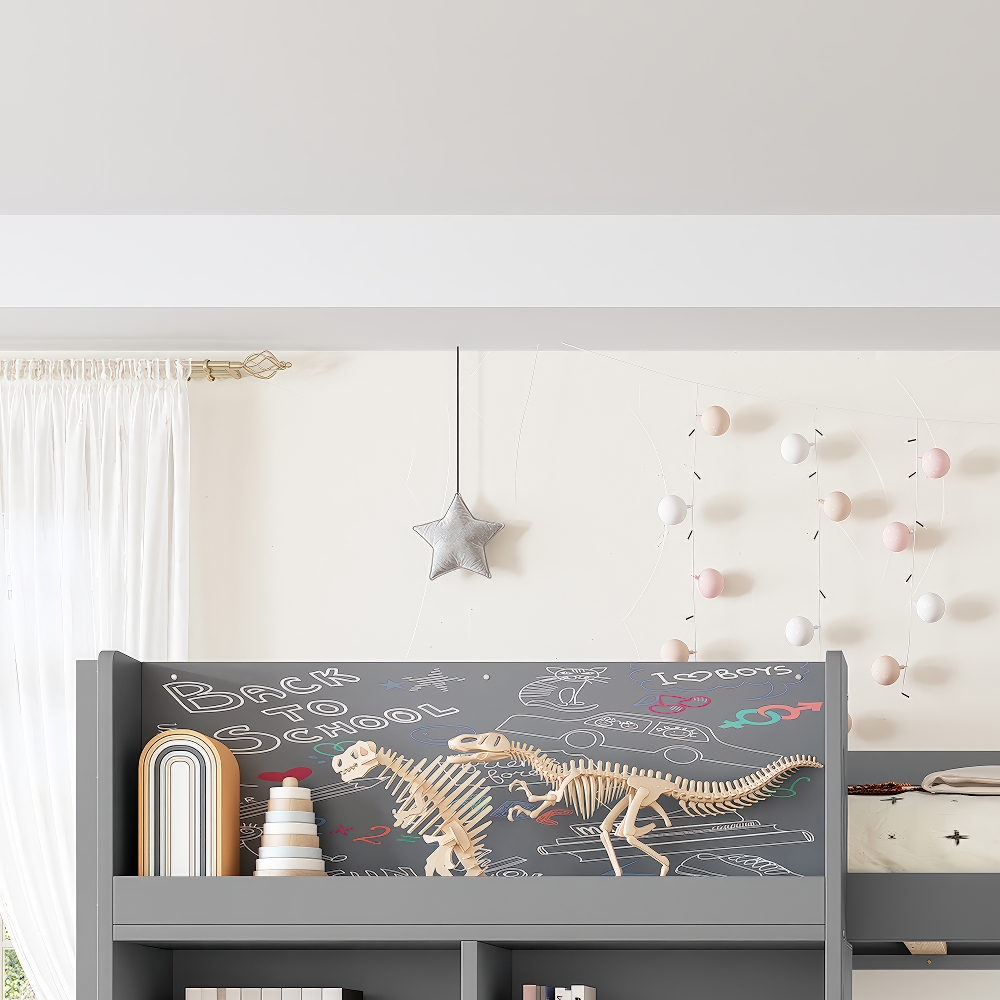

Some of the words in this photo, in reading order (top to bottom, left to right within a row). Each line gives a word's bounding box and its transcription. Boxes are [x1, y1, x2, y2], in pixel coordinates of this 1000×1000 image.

[162, 667, 361, 713] BACK
[651, 671, 678, 686] I
[714, 665, 793, 681] BOYS
[261, 700, 348, 722] TO
[213, 703, 460, 755] SCHOOL
